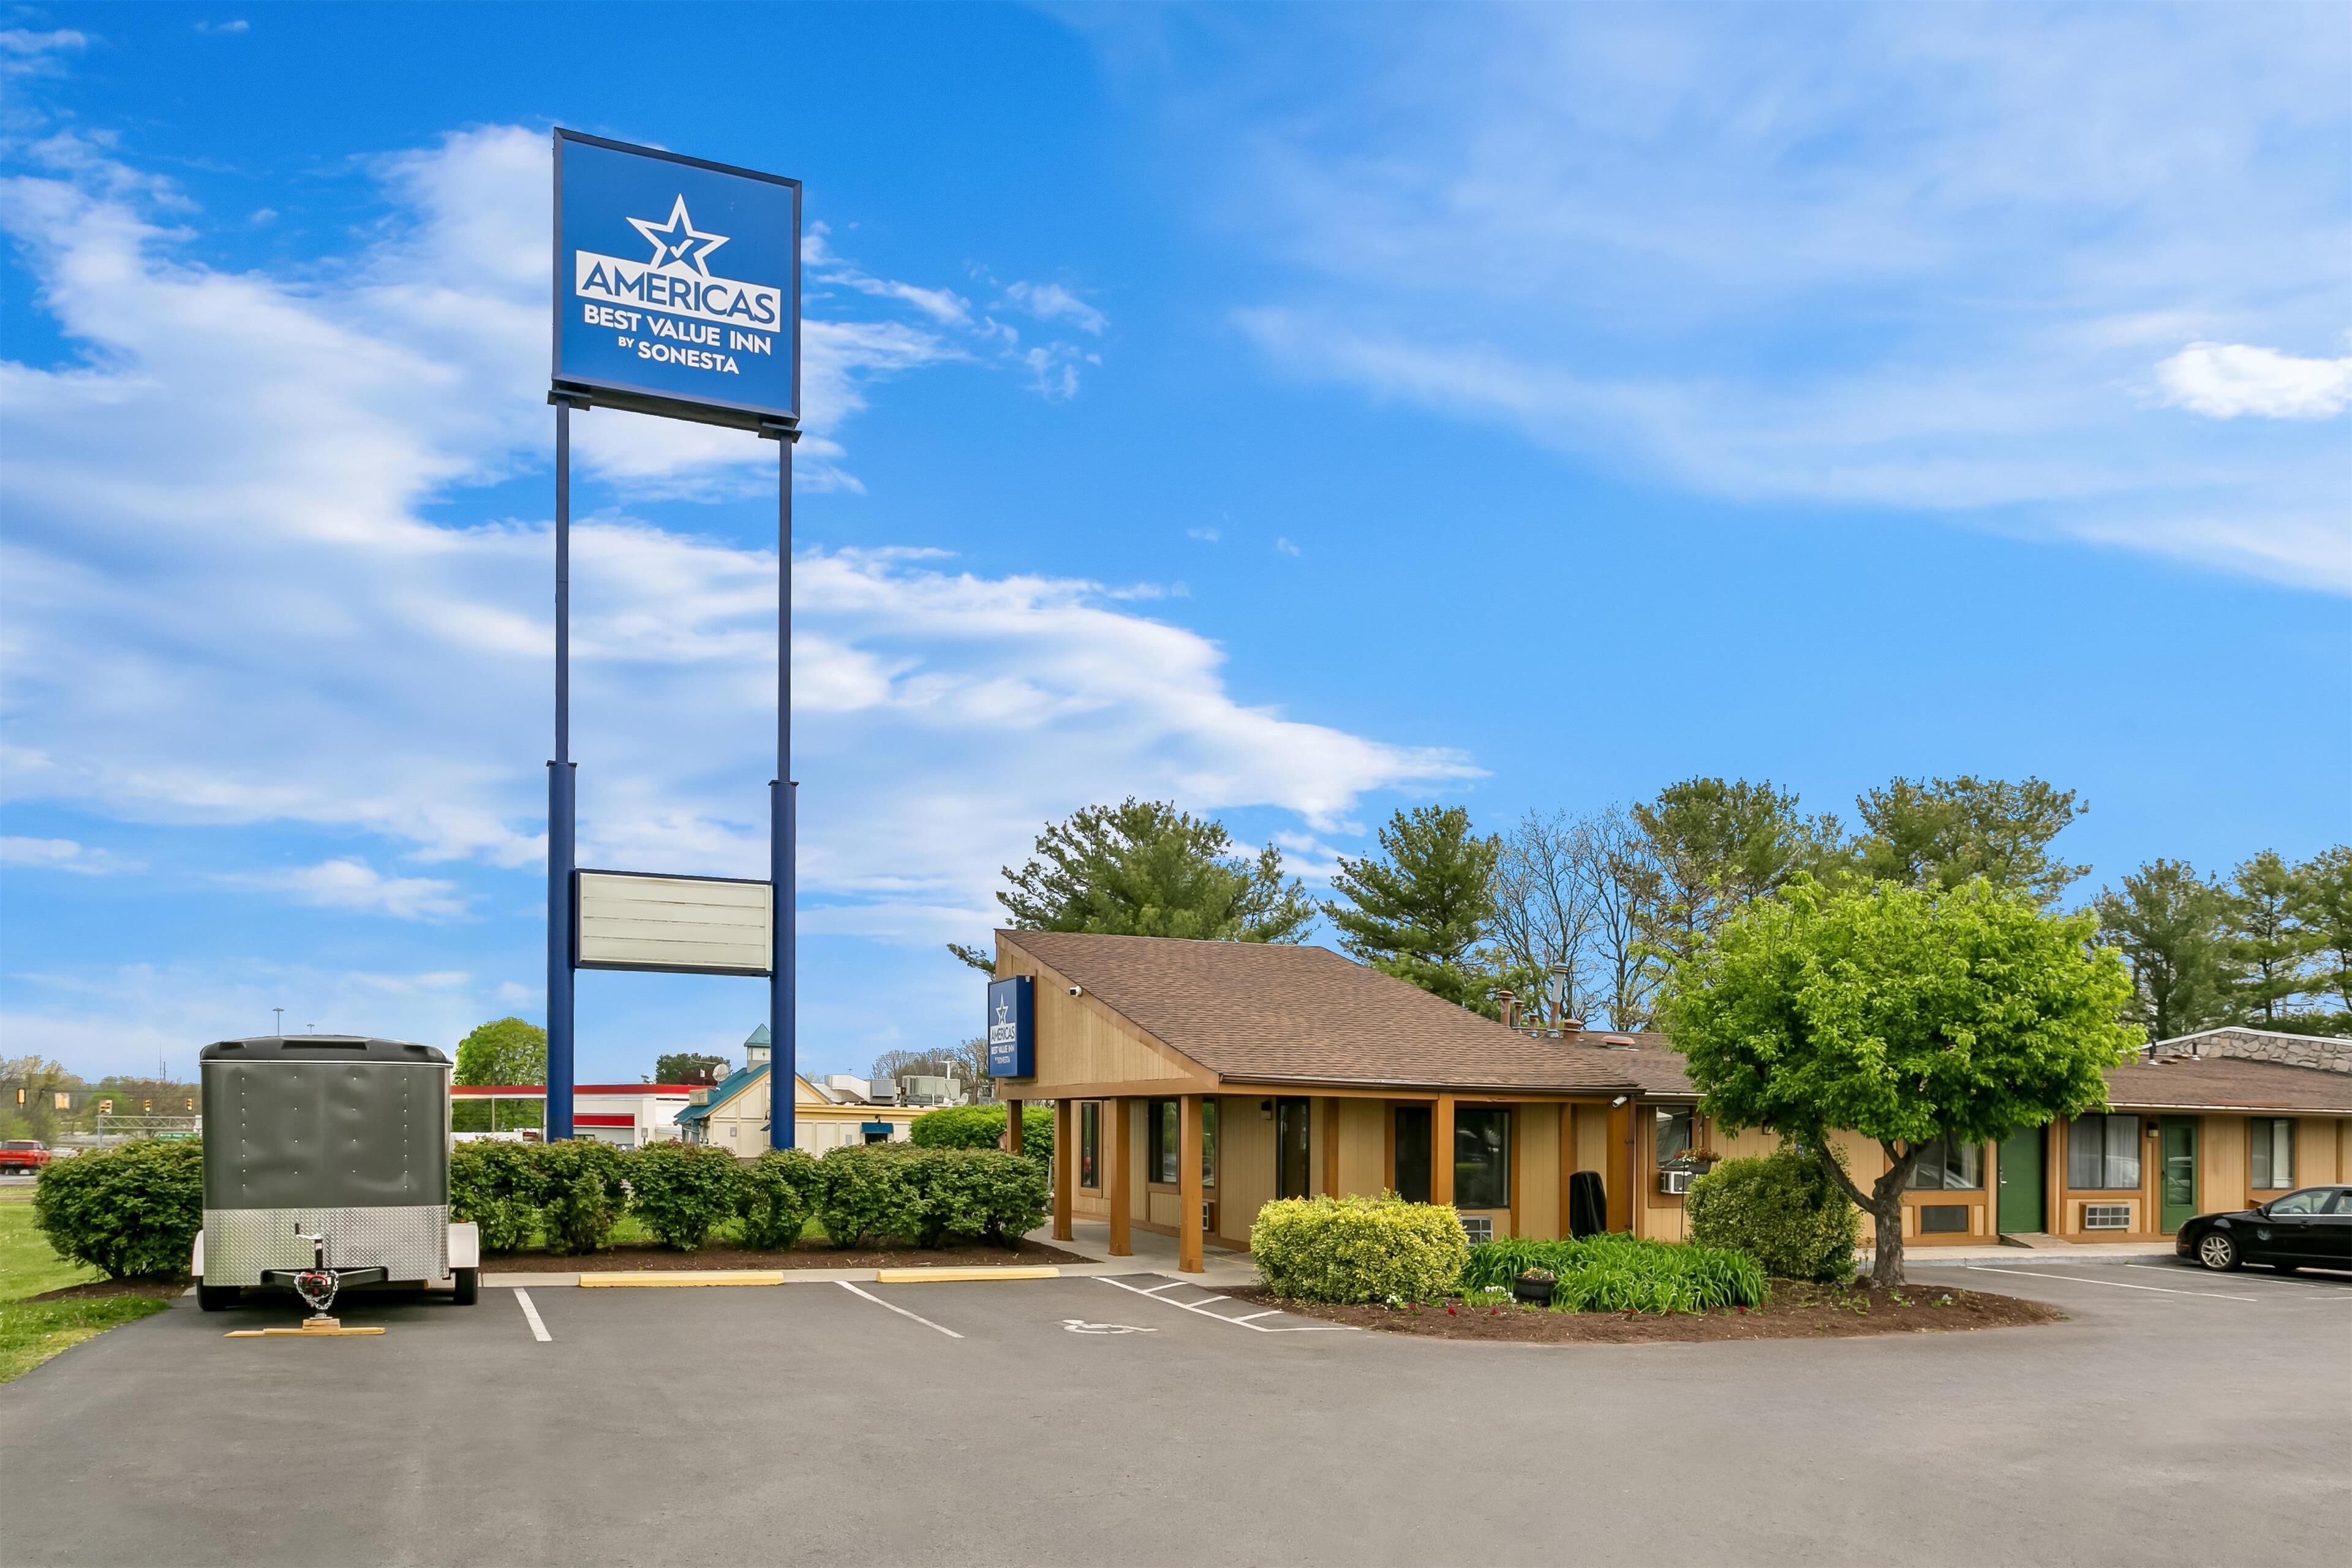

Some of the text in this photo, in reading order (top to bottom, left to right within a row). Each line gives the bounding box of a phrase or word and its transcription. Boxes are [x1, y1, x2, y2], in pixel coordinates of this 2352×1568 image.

[582, 261, 775, 324] AMERICAS
[584, 304, 771, 355] BEST VALUE INN
[619, 336, 739, 374] BY SONESTA
[991, 1025, 1015, 1041] AMERICAS
